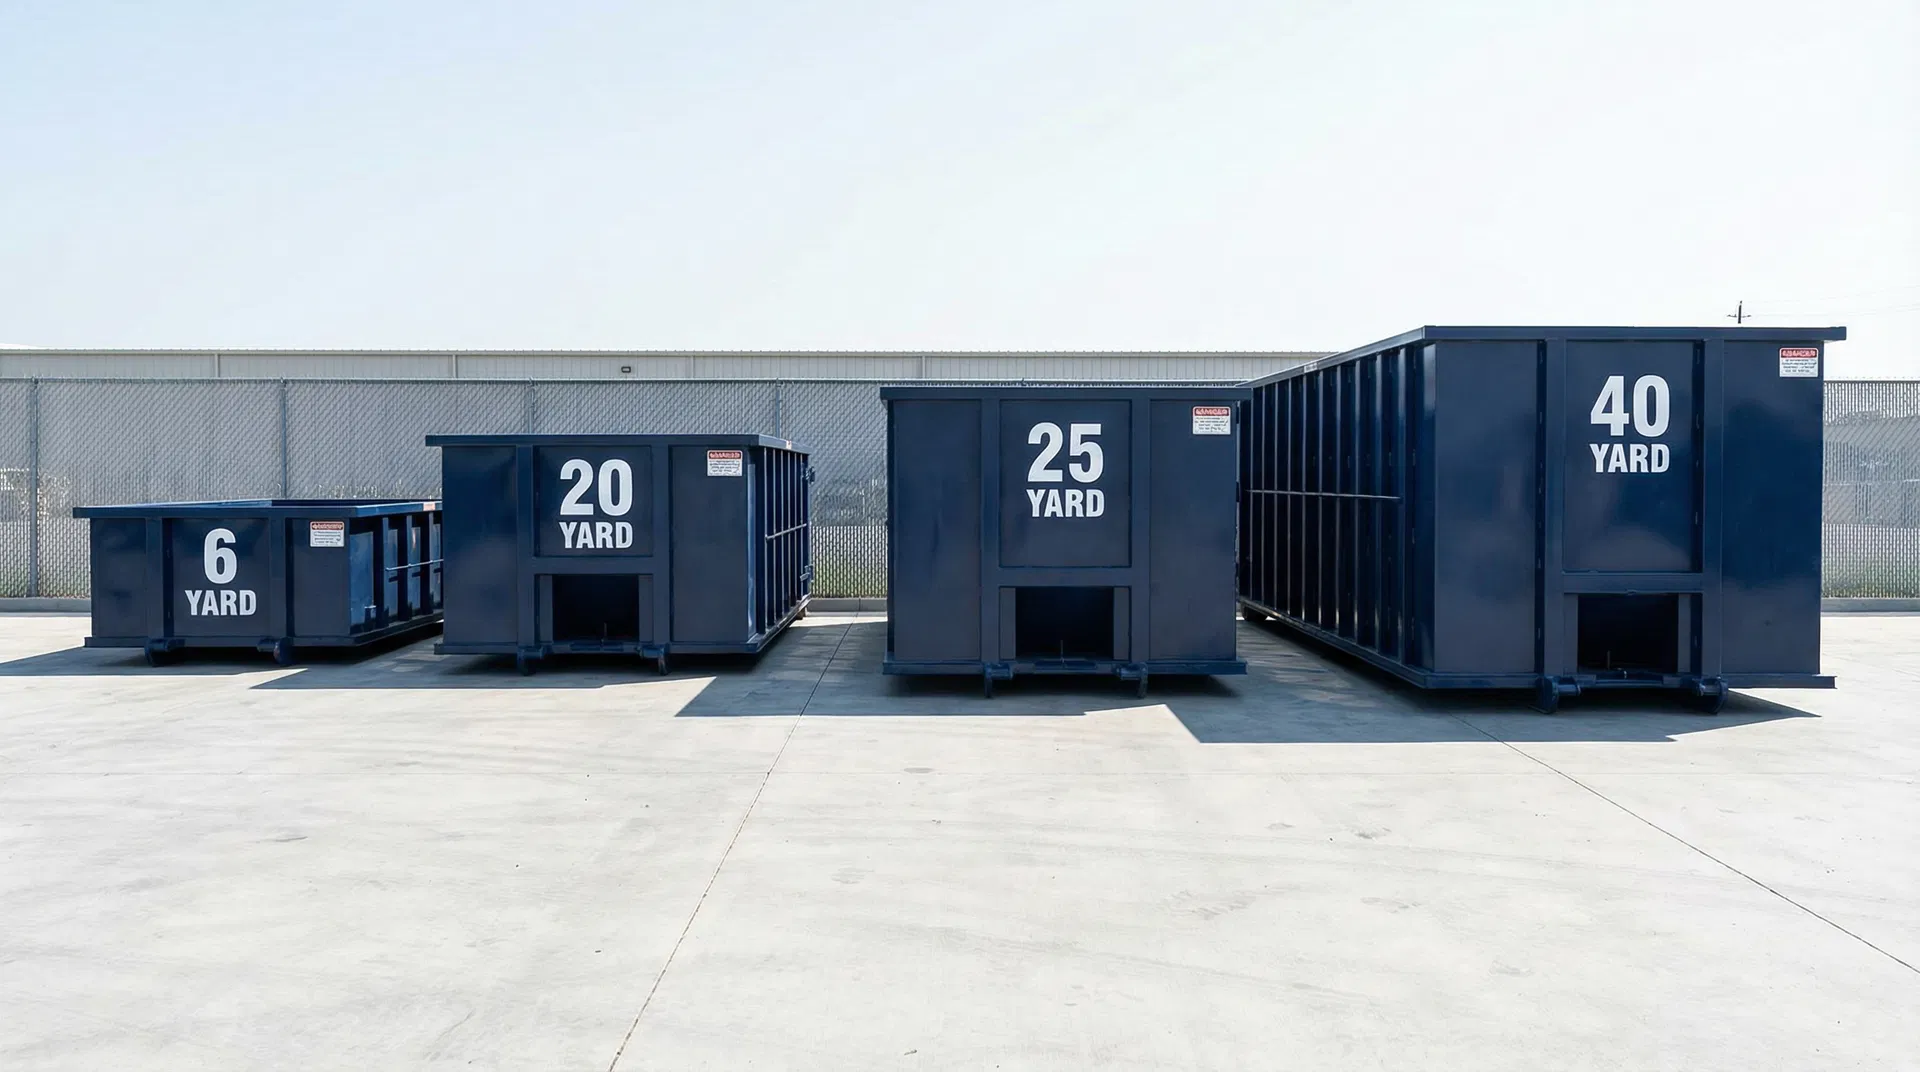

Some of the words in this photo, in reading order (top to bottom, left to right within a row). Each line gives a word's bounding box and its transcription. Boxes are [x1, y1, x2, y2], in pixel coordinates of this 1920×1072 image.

[1590, 374, 1670, 438] 40
[1027, 422, 1104, 483] 25
[1589, 443, 1670, 473] YARD
[559, 458, 633, 517] 20
[1026, 488, 1105, 518] YARD
[204, 527, 237, 584] 6
[559, 521, 633, 549] YARD
[184, 589, 257, 616] YARD
